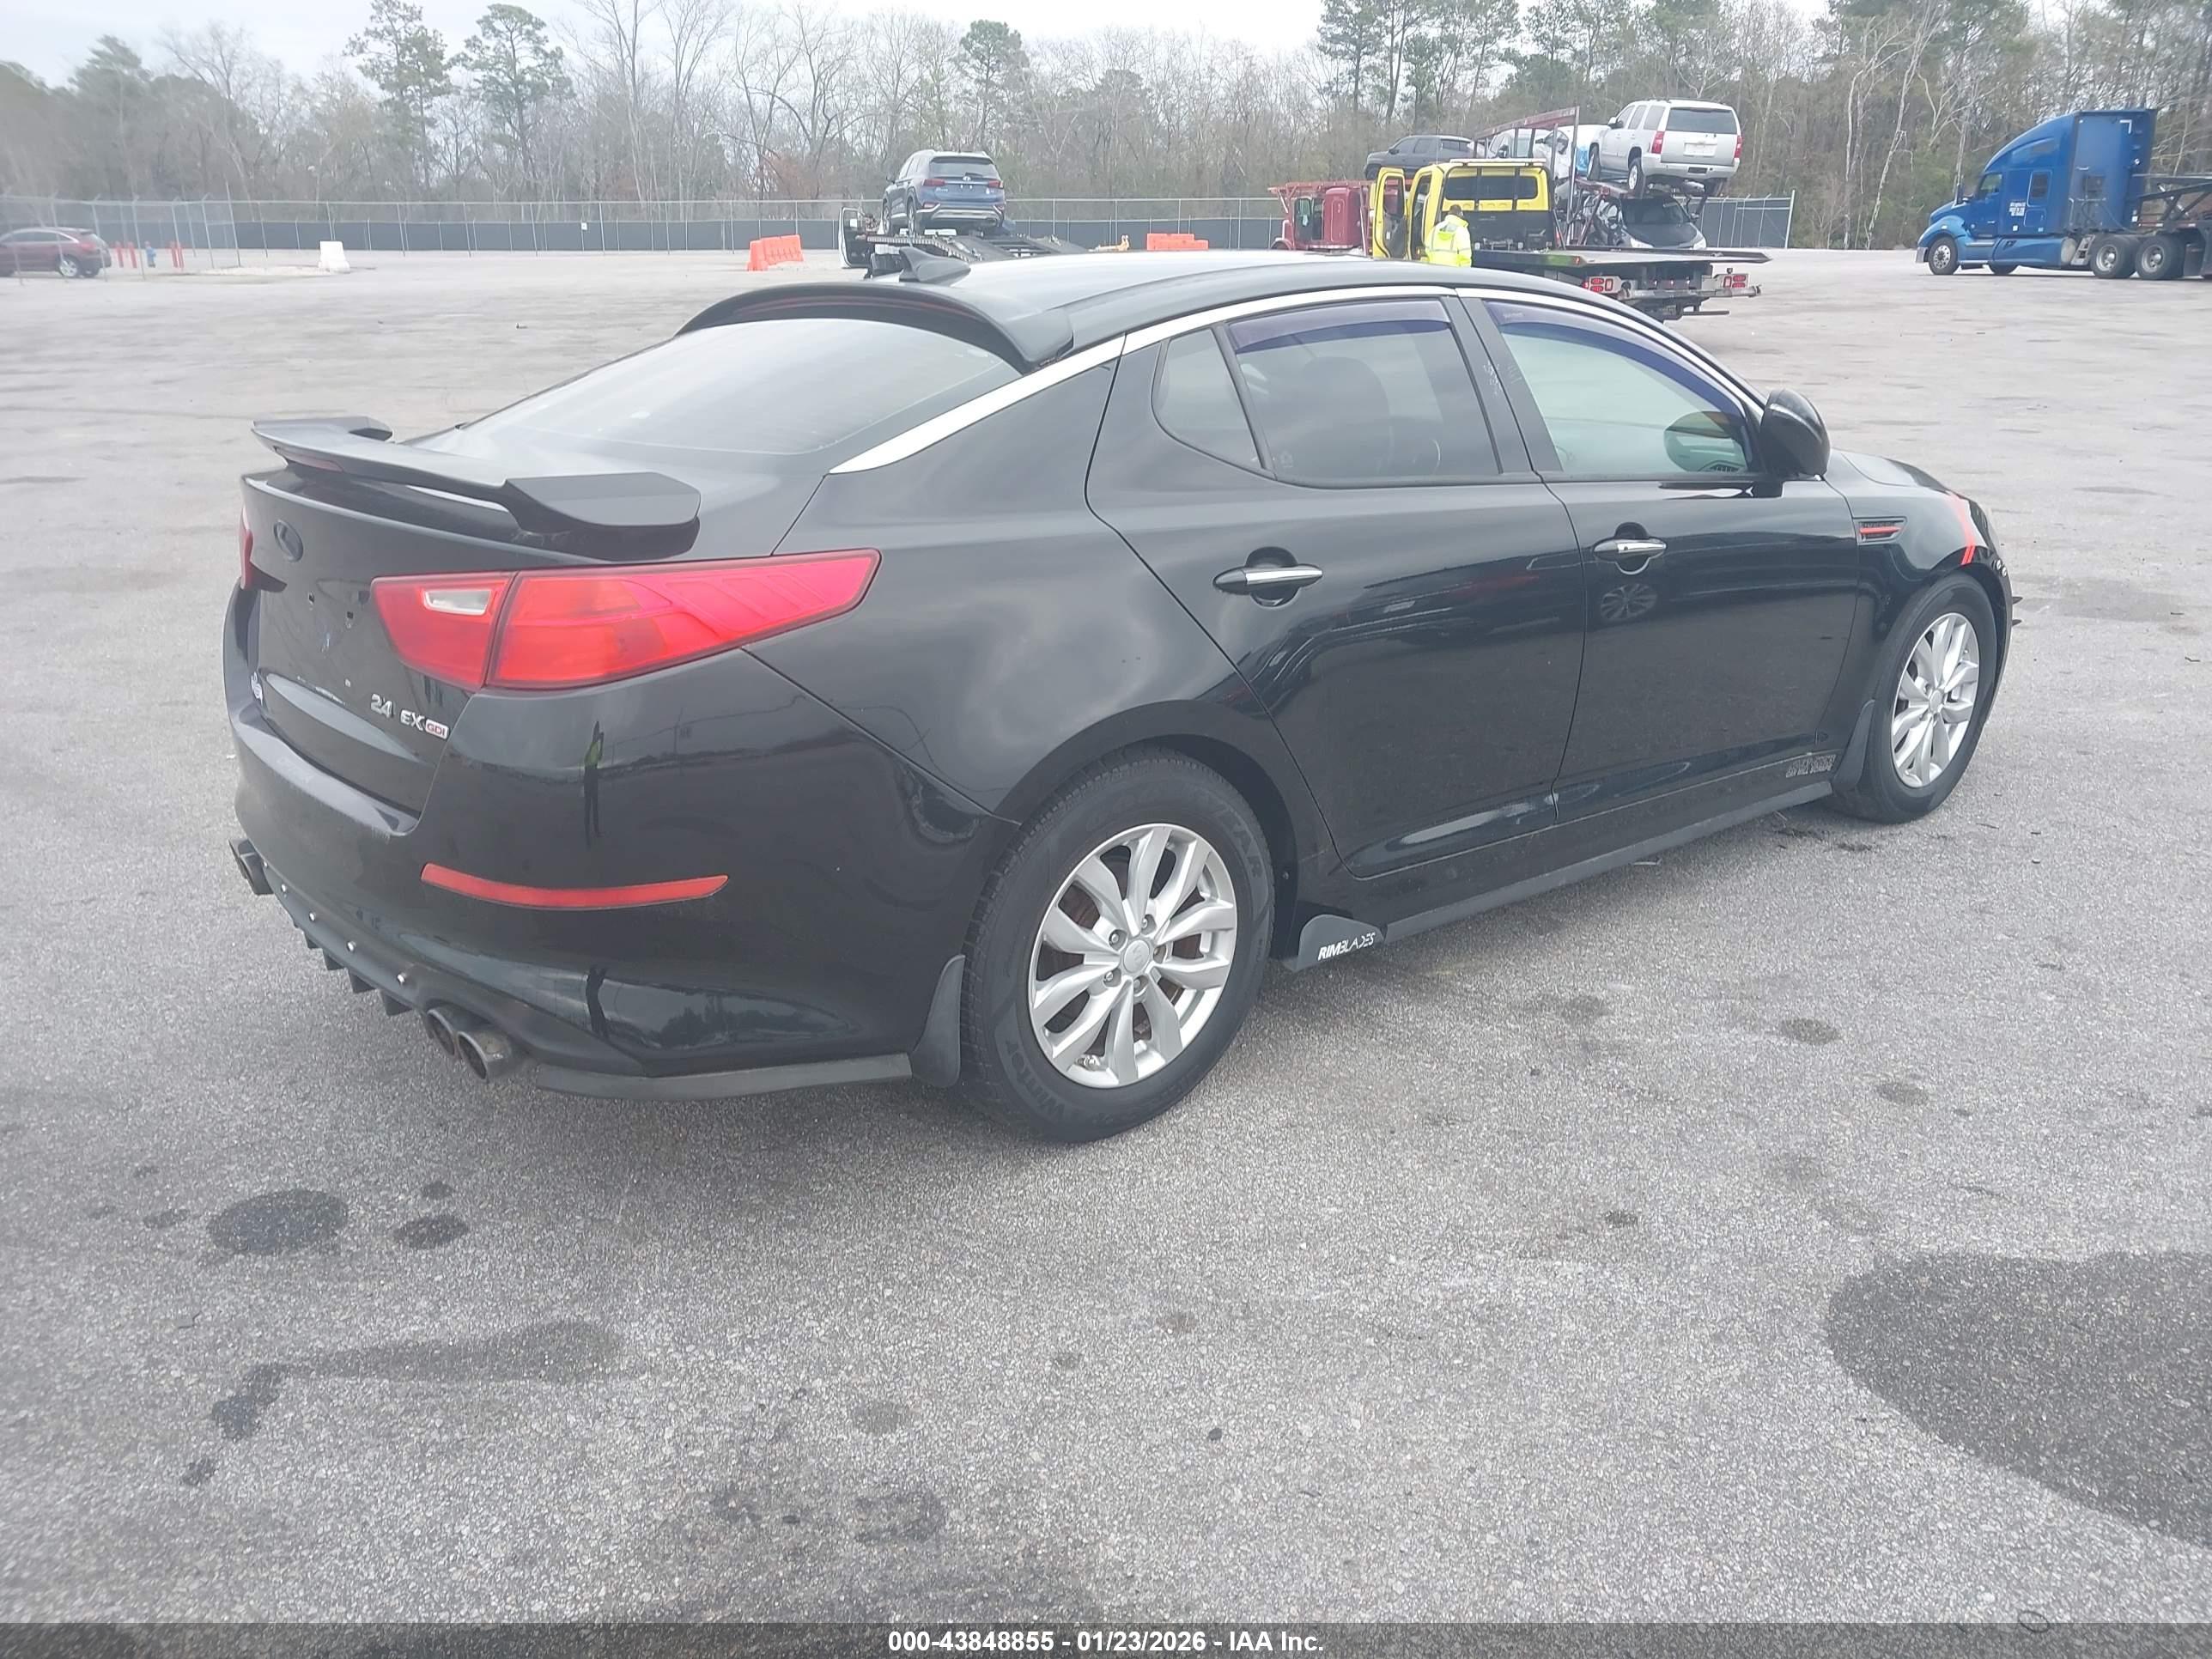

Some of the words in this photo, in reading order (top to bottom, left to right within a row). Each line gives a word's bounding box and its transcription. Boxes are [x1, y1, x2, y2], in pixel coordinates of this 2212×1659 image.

[400, 709, 425, 732] EX
[426, 721, 447, 738] GDI
[1317, 932, 1376, 961] RIMBLADES
